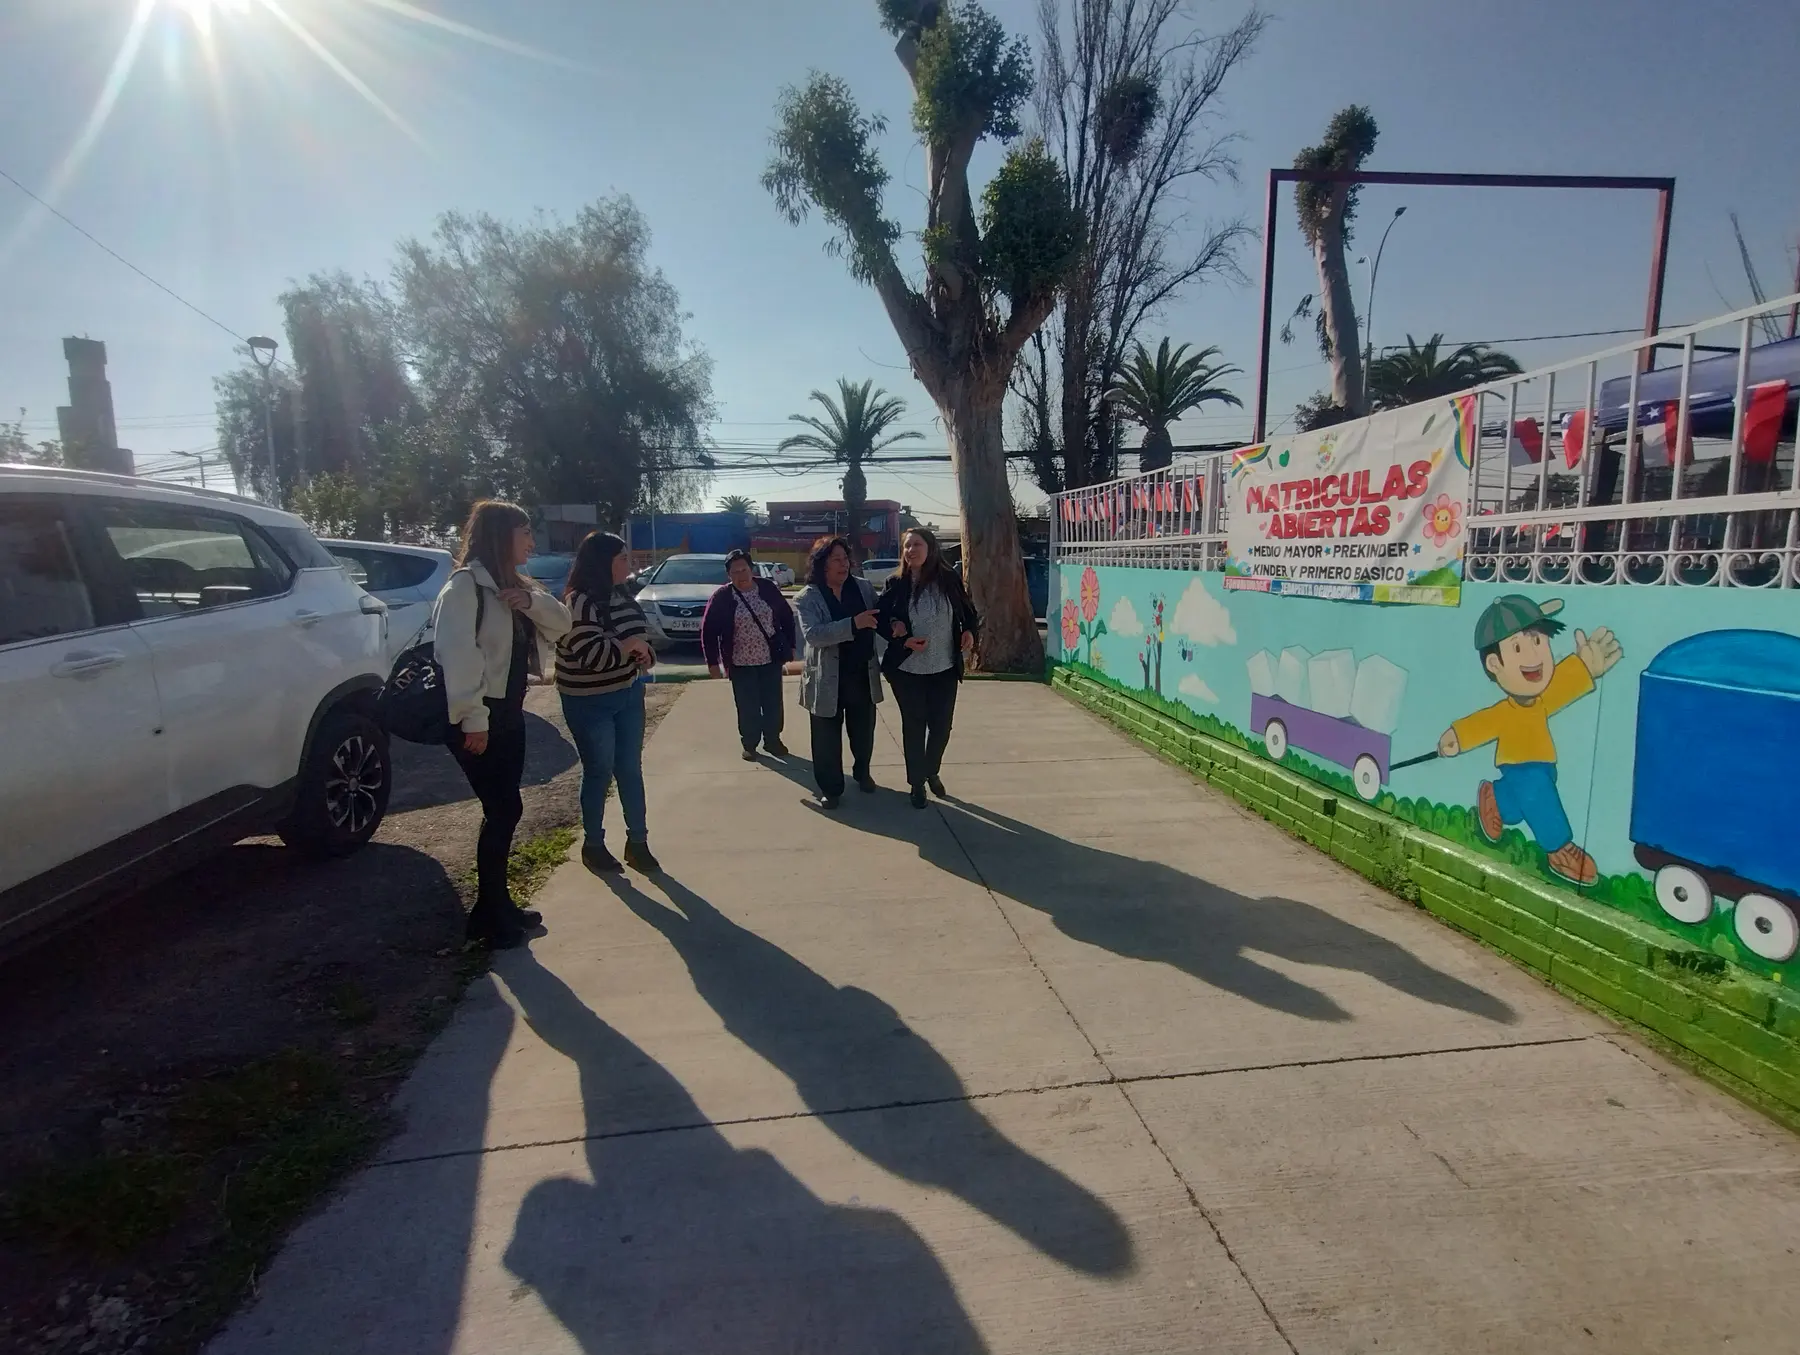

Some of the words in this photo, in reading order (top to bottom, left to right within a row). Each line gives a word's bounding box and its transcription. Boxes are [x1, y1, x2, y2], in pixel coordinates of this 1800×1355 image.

[1246, 459, 1432, 514] MATRICULAS
[1265, 504, 1391, 540] ABIERTAS
[1253, 545, 1281, 558] MEDIO
[1283, 545, 1323, 558] MAYOR
[1332, 542, 1409, 558] PREKINDER
[1252, 564, 1288, 577] KINDER
[1290, 565, 1298, 578] Y
[1299, 566, 1351, 580] PRIMERO
[1353, 566, 1404, 581] BASICO
